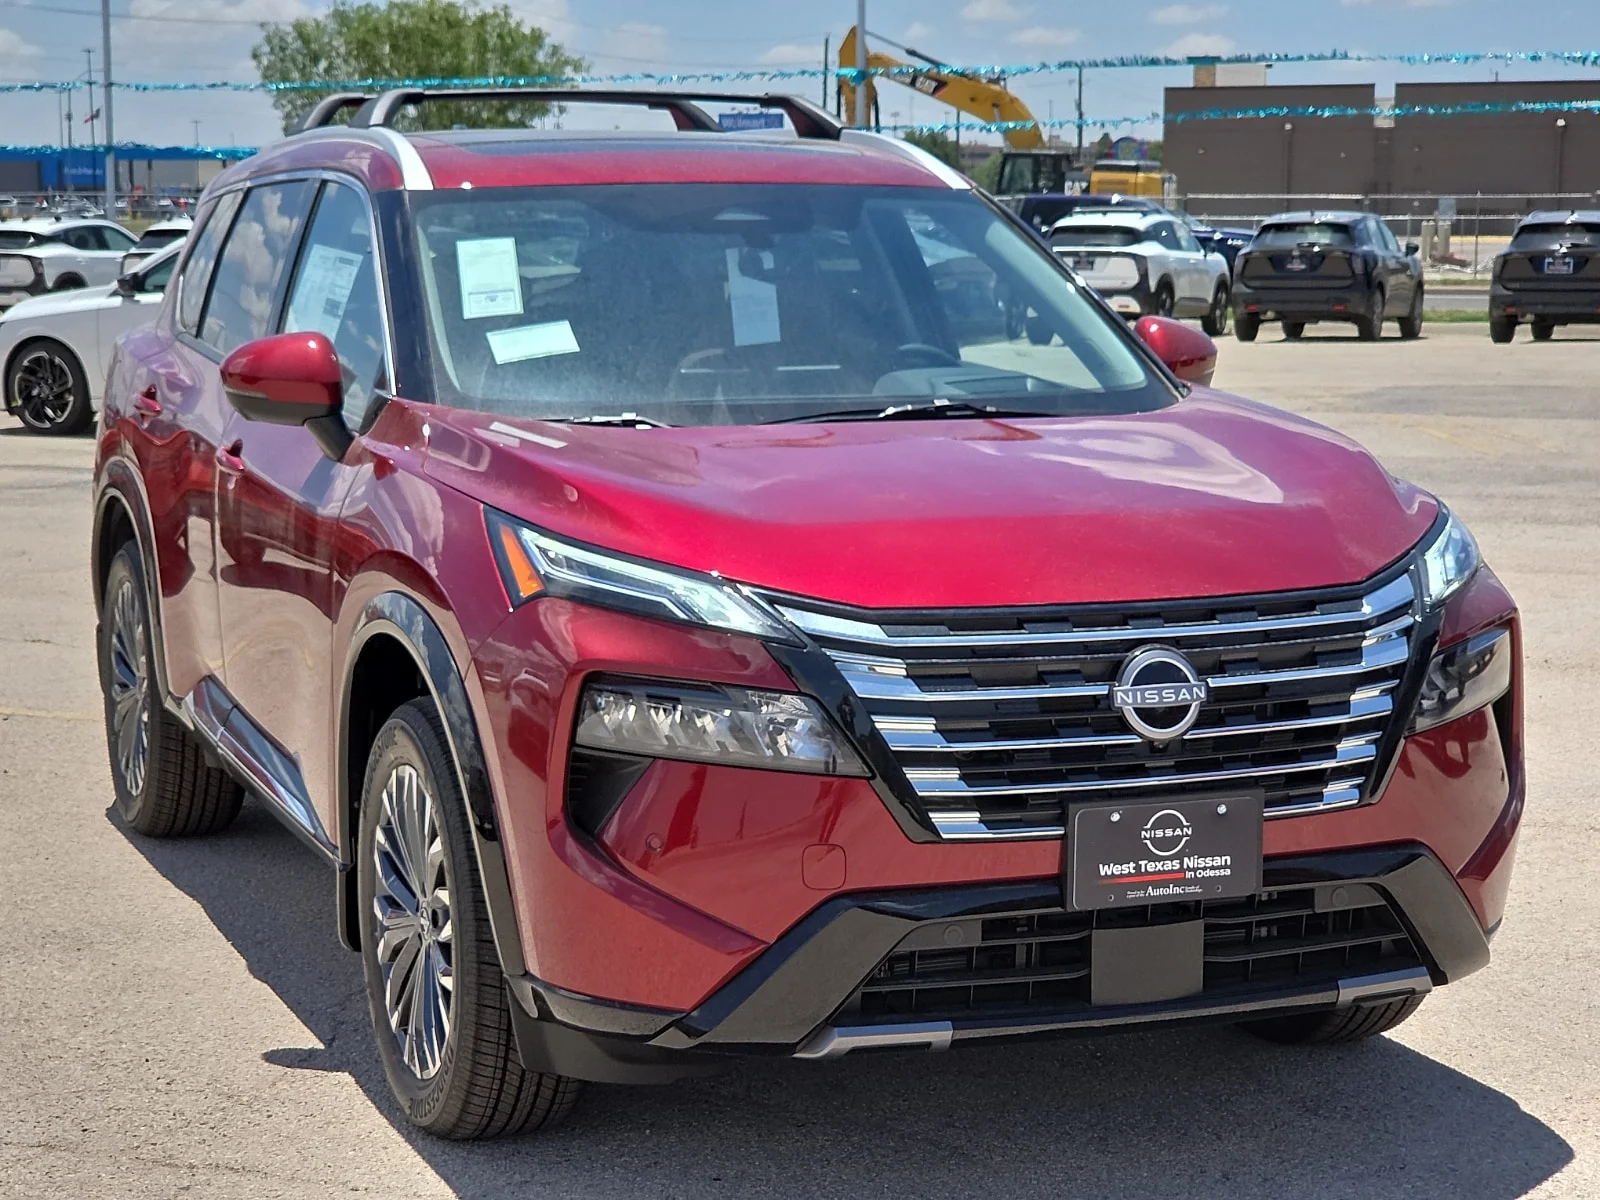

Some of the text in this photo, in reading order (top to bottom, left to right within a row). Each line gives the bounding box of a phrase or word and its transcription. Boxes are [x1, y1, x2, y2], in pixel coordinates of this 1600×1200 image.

[1116, 686, 1205, 704] NISSAN
[1141, 827, 1192, 838] NISSAN
[1099, 855, 1231, 876] West Texas Nissan
[1196, 867, 1231, 878] Odessa
[1145, 884, 1185, 897] AutoInc
